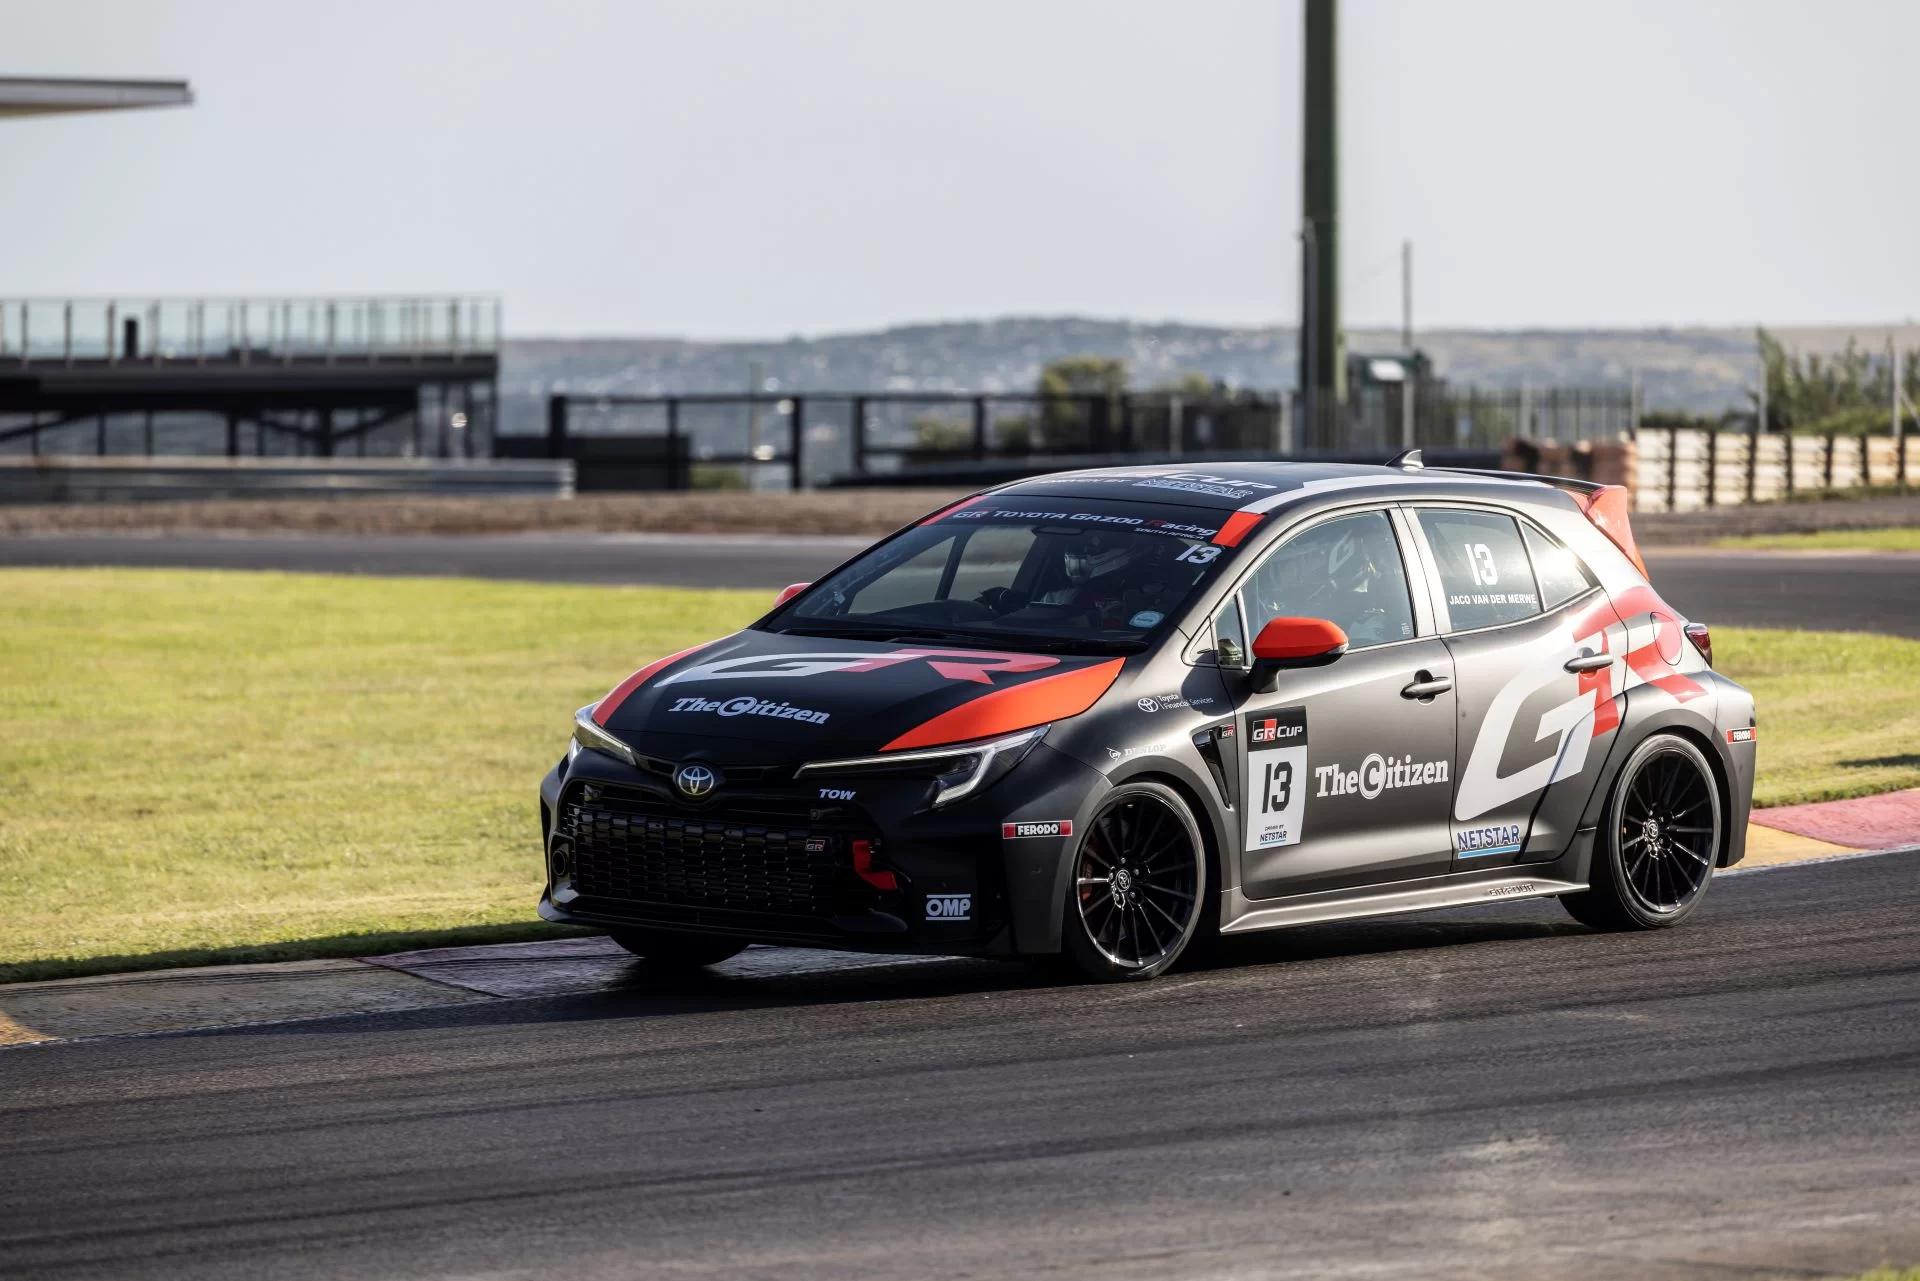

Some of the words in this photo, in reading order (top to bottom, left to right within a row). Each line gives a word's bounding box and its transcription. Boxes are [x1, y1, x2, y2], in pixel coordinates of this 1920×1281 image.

[993, 511, 1068, 519] TOYOTA
[1070, 513, 1144, 525] GAZOO
[1145, 520, 1219, 535] Racing
[1175, 544, 1222, 564] 13
[1464, 544, 1498, 585] 13
[1449, 595, 1470, 605] JACO
[1471, 594, 1489, 604] VAN
[1490, 594, 1507, 604] DER
[1508, 593, 1537, 604] MERWE
[819, 788, 856, 800] TOW
[1262, 761, 1293, 814] 13
[1017, 824, 1059, 836] FERODO
[1260, 830, 1287, 842] NETSTAR
[1457, 824, 1520, 850] NETSTAR
[926, 899, 971, 917] OMP
